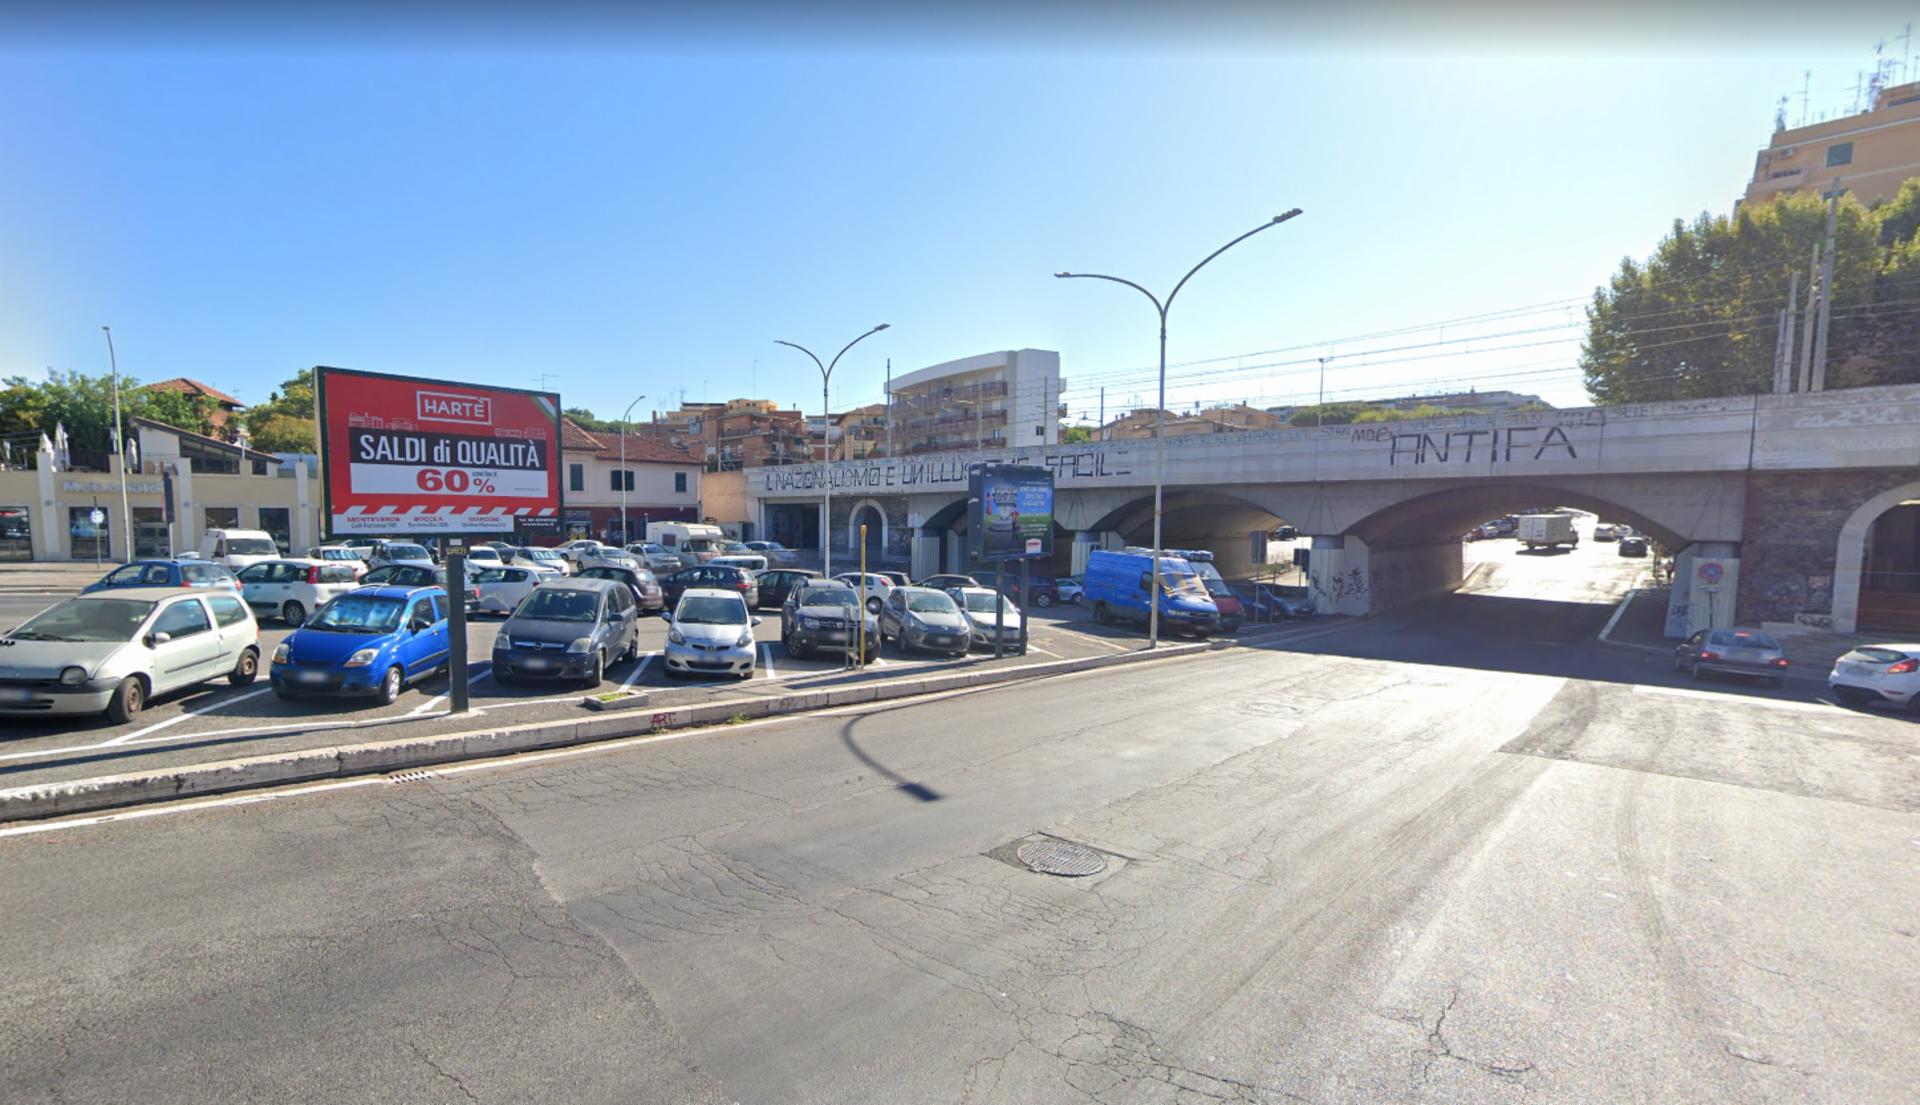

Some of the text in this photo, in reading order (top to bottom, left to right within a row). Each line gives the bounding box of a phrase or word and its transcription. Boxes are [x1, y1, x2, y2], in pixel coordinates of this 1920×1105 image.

[423, 396, 486, 418] HARTÈ
[360, 434, 541, 468] SALDI di QUALITÀ
[1390, 427, 1577, 466] ANTIFA
